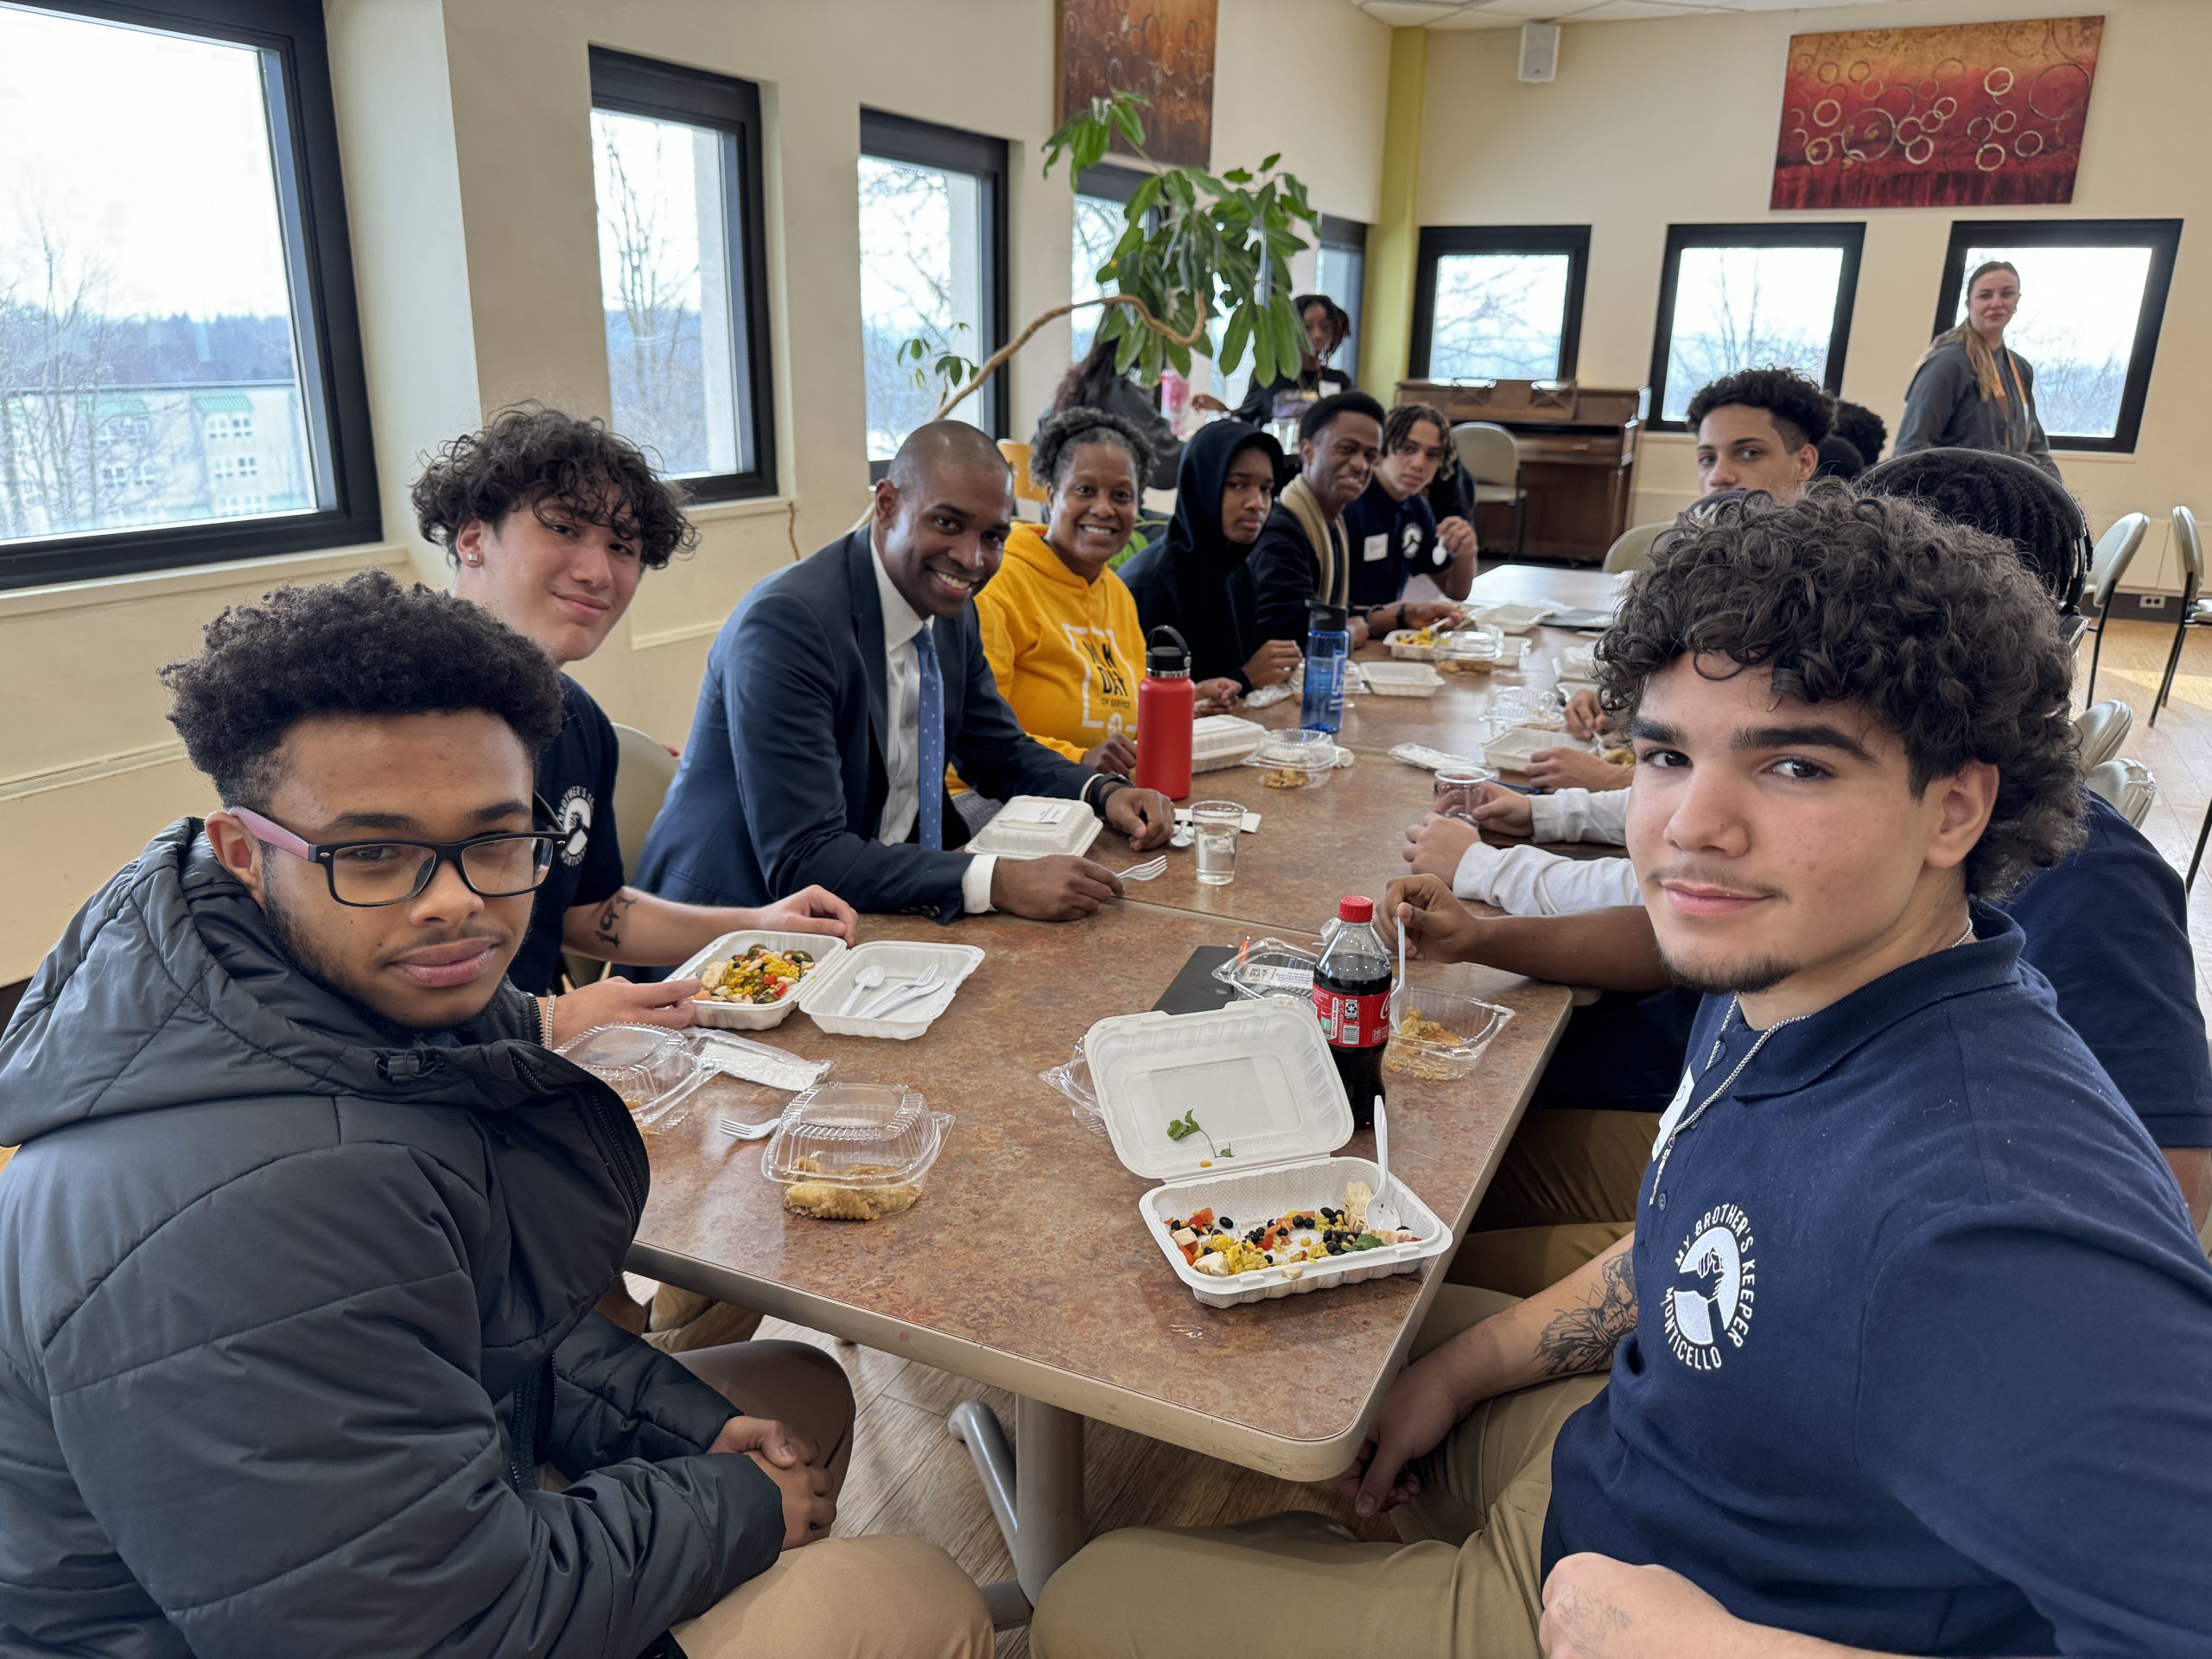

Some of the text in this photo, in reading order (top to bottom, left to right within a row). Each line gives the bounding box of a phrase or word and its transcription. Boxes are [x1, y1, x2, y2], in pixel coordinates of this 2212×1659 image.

[1101, 697, 1109, 706] OF
[1675, 1203, 1757, 1348] MY BROTHER'S KEEPER
[1663, 1286, 1723, 1370] MONTICELLO
